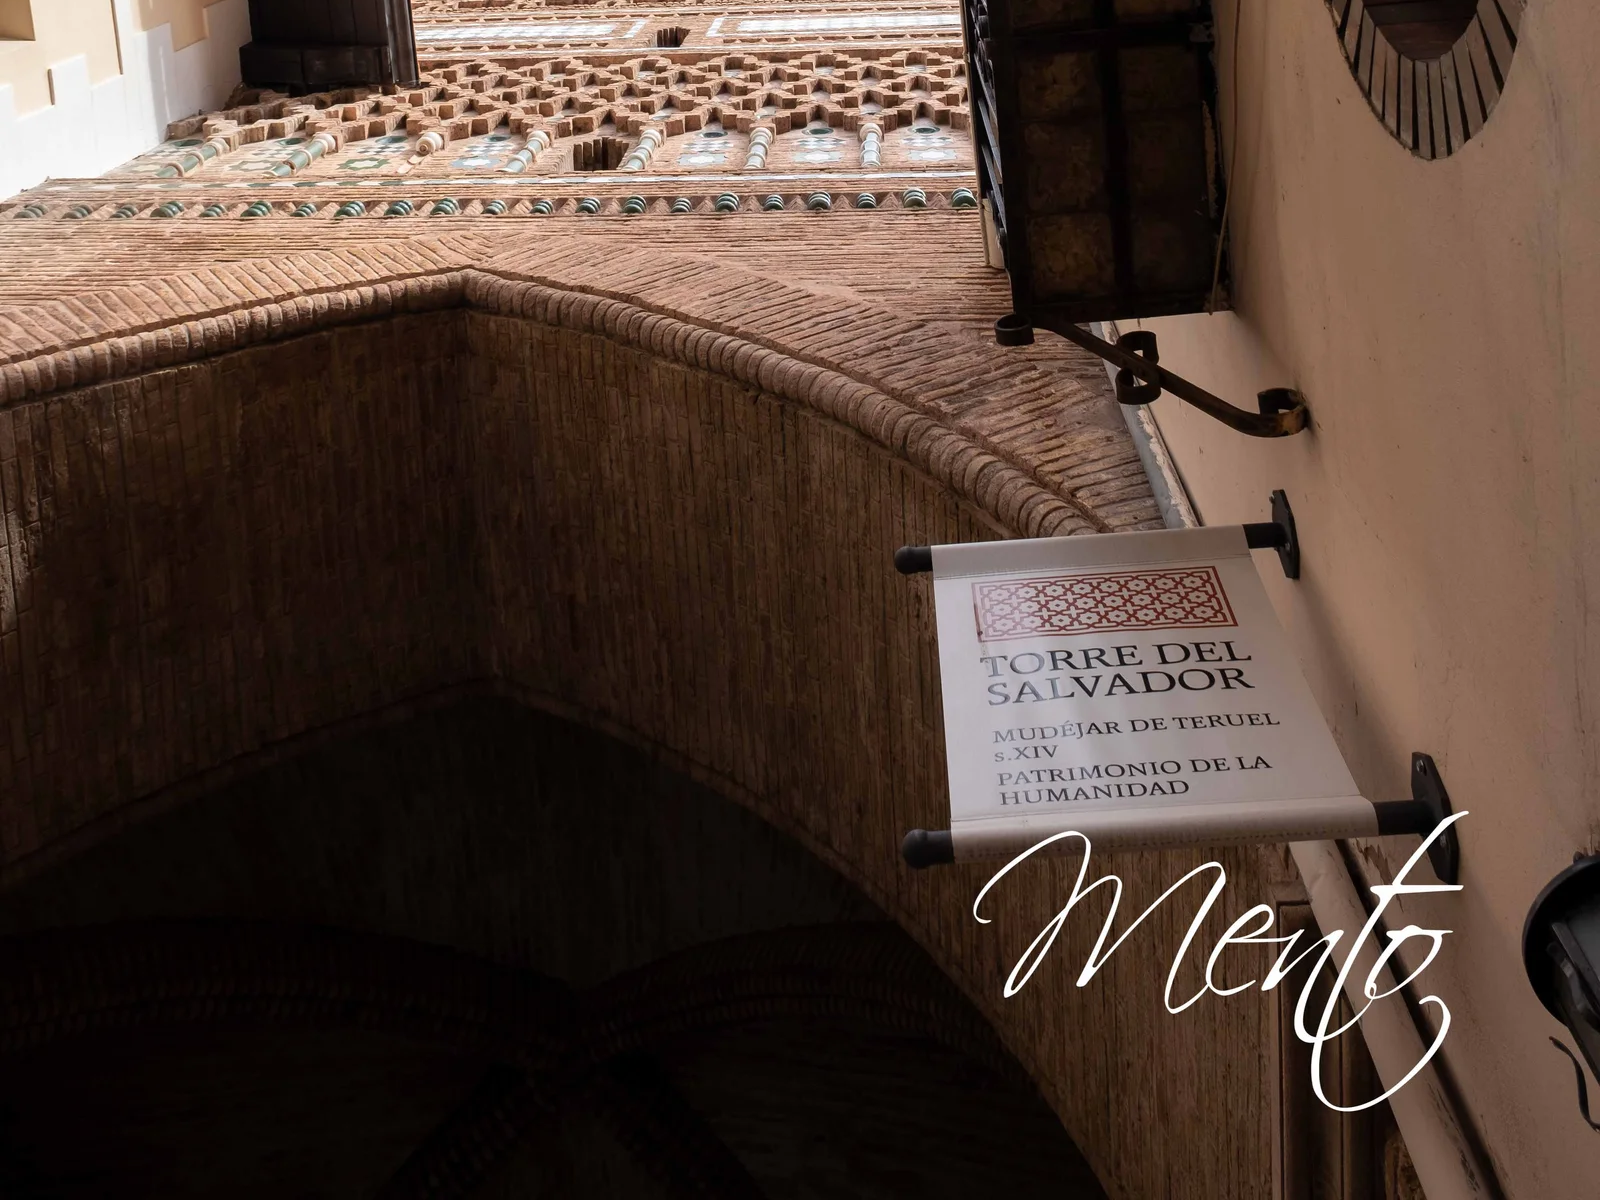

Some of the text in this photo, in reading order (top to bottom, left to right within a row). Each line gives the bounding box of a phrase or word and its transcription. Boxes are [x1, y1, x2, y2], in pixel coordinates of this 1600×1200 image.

[980, 640, 1252, 678] TORRE DEL
[987, 667, 1255, 706] SALVADOR
[993, 713, 1280, 743] MUDÉJAR DE TERUEL
[994, 745, 1059, 763] s.XIV
[997, 755, 1273, 786] PATRIMONIO DE LA
[999, 780, 1190, 805] HUMANIDAD
